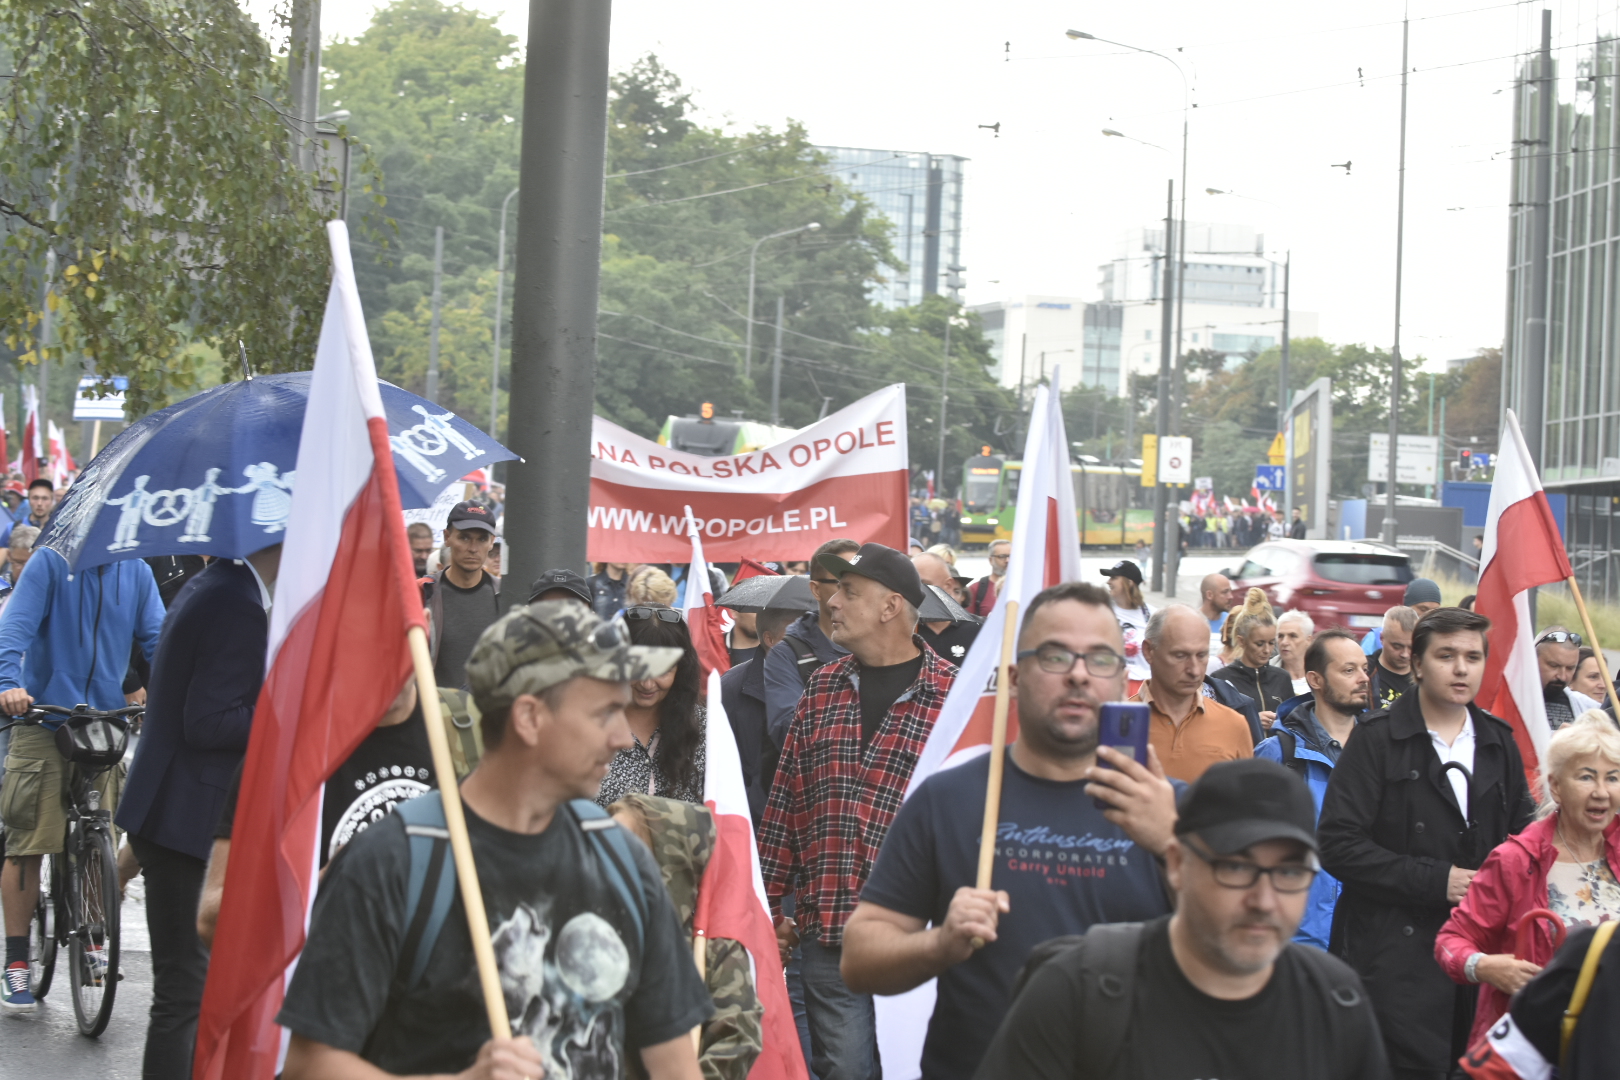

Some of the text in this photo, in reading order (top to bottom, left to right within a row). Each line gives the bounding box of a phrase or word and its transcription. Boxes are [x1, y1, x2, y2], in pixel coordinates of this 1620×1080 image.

[591, 420, 896, 479] NA POLSKA OPOLE
[994, 847, 1128, 866] NCORPORATED
[1008, 858, 1106, 879] Carry Untold
